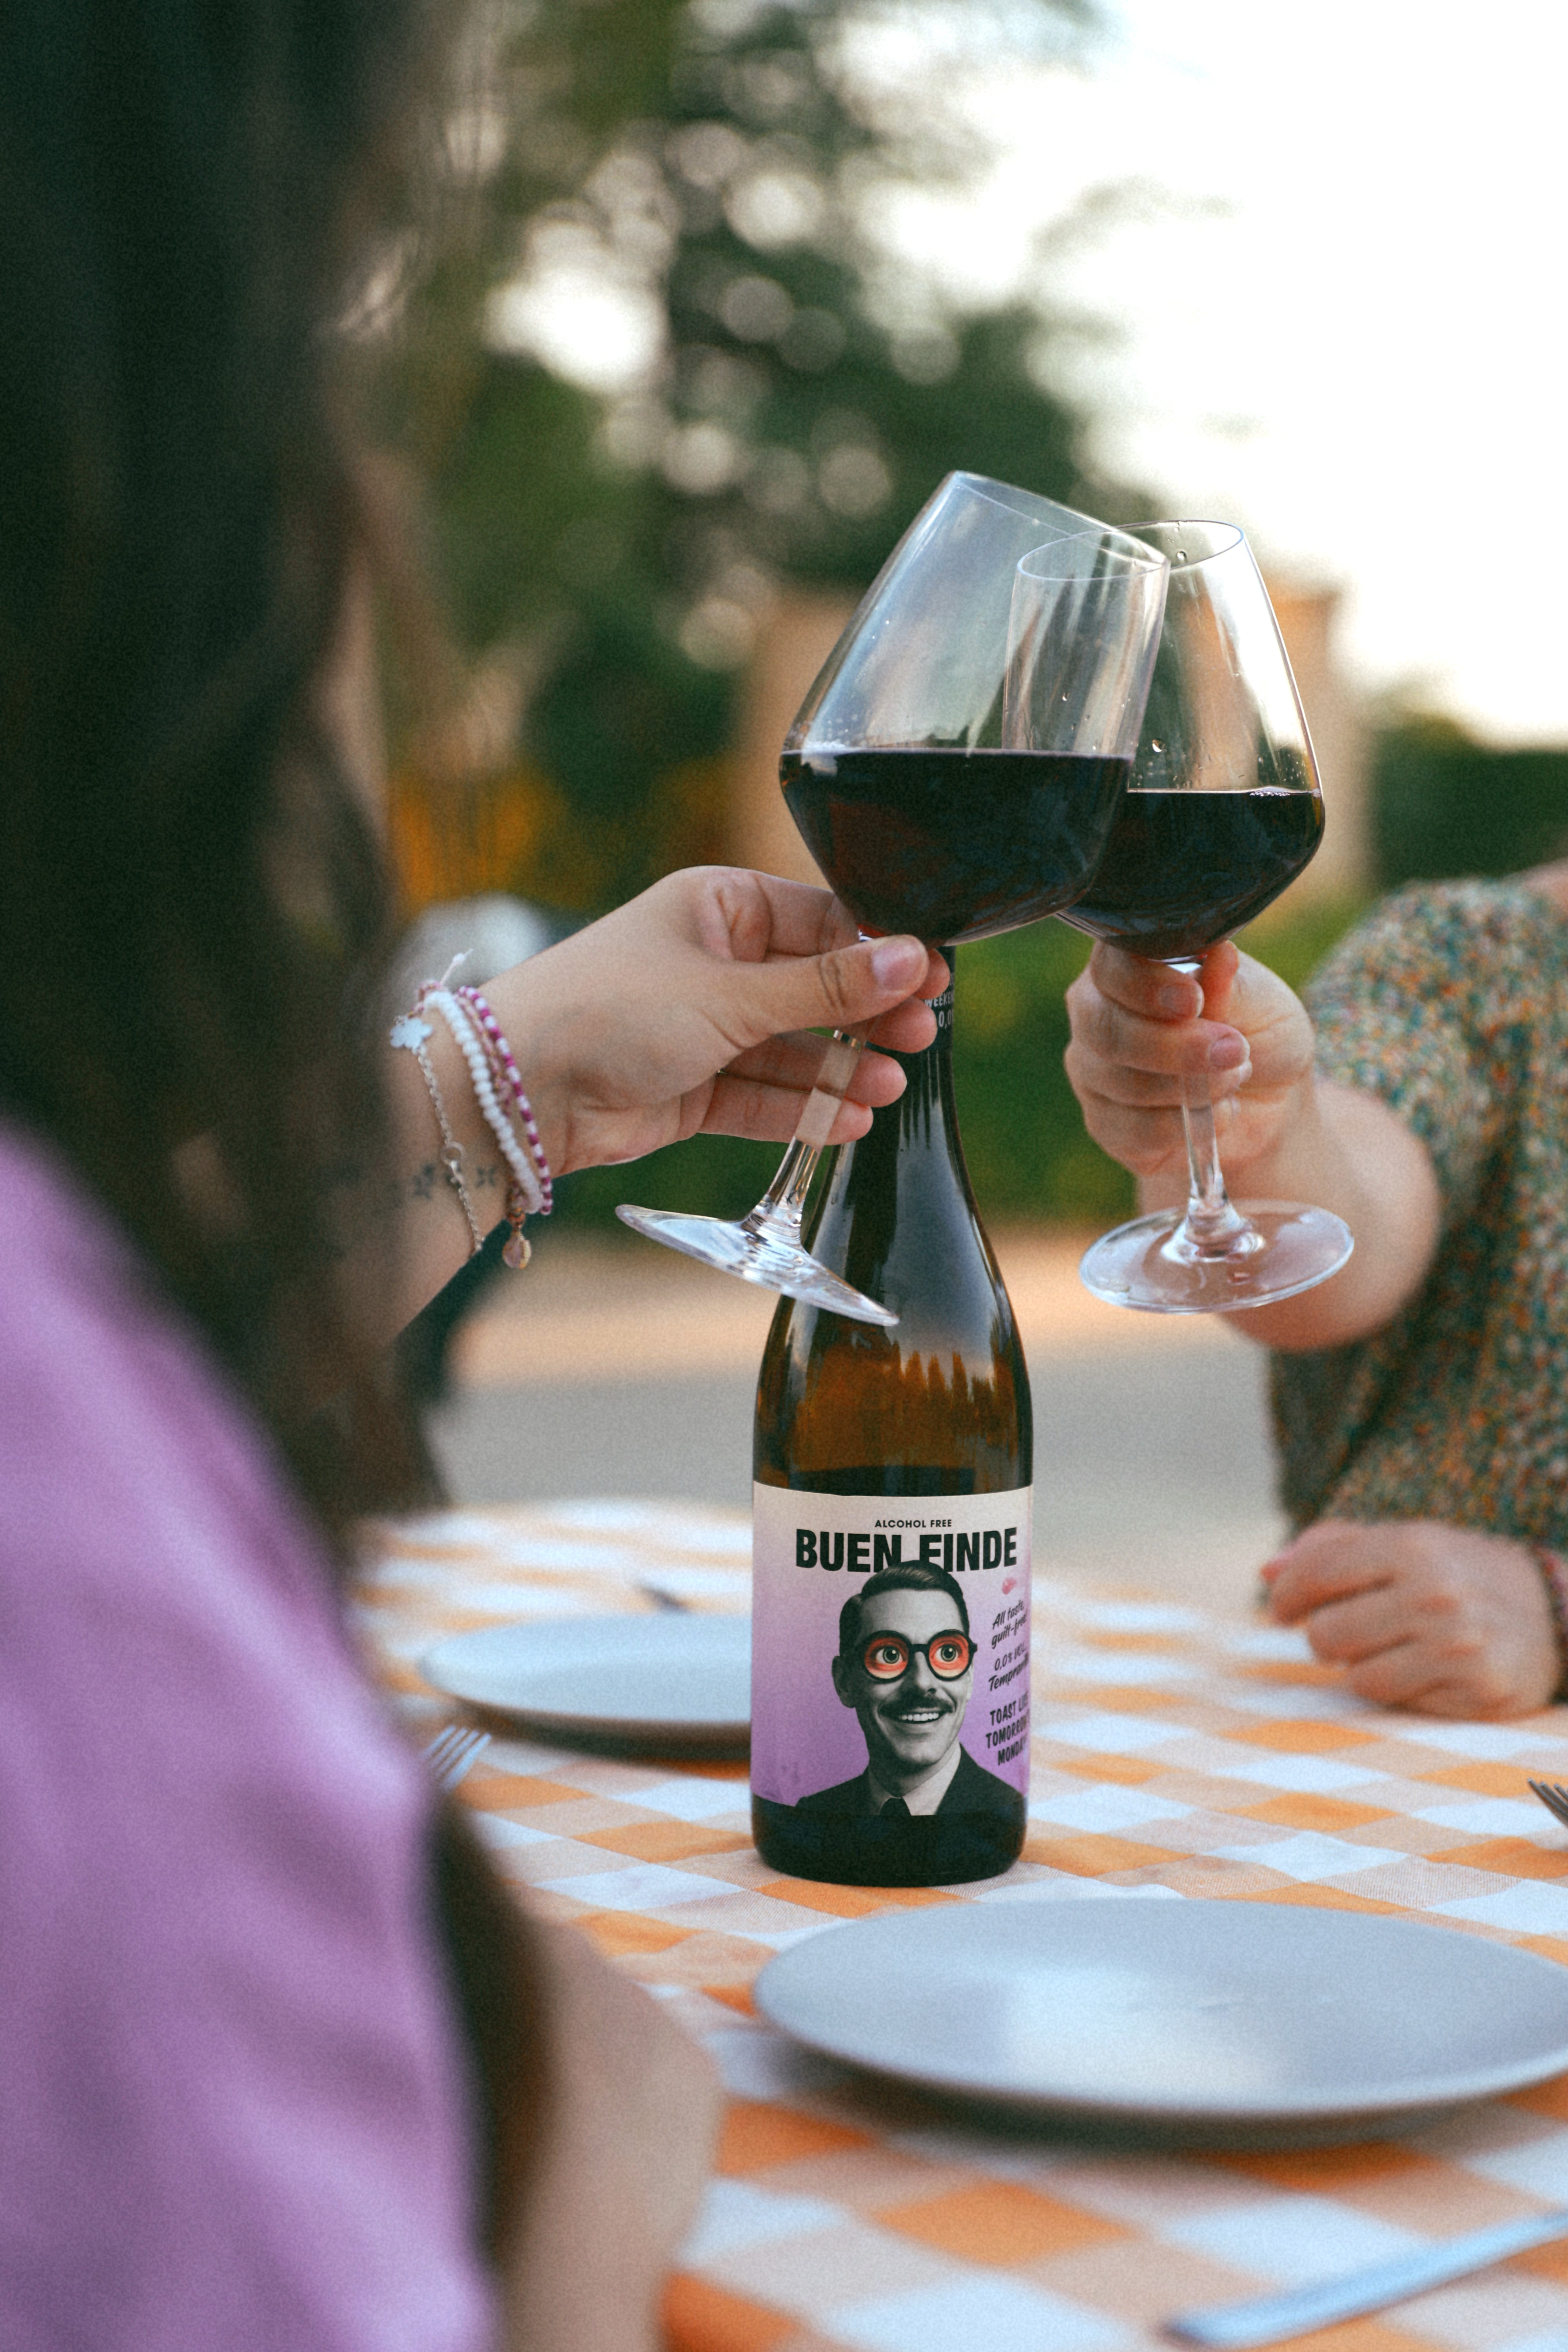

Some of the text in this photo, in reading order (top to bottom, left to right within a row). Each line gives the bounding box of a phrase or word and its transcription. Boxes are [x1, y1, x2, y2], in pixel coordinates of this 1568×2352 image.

[874, 1519, 952, 1528] ALCOHOL FREE
[795, 1527, 1017, 1573] BUEN FINDE
[992, 1610, 1006, 1630] All
[989, 1700, 1016, 1726] TOAST
